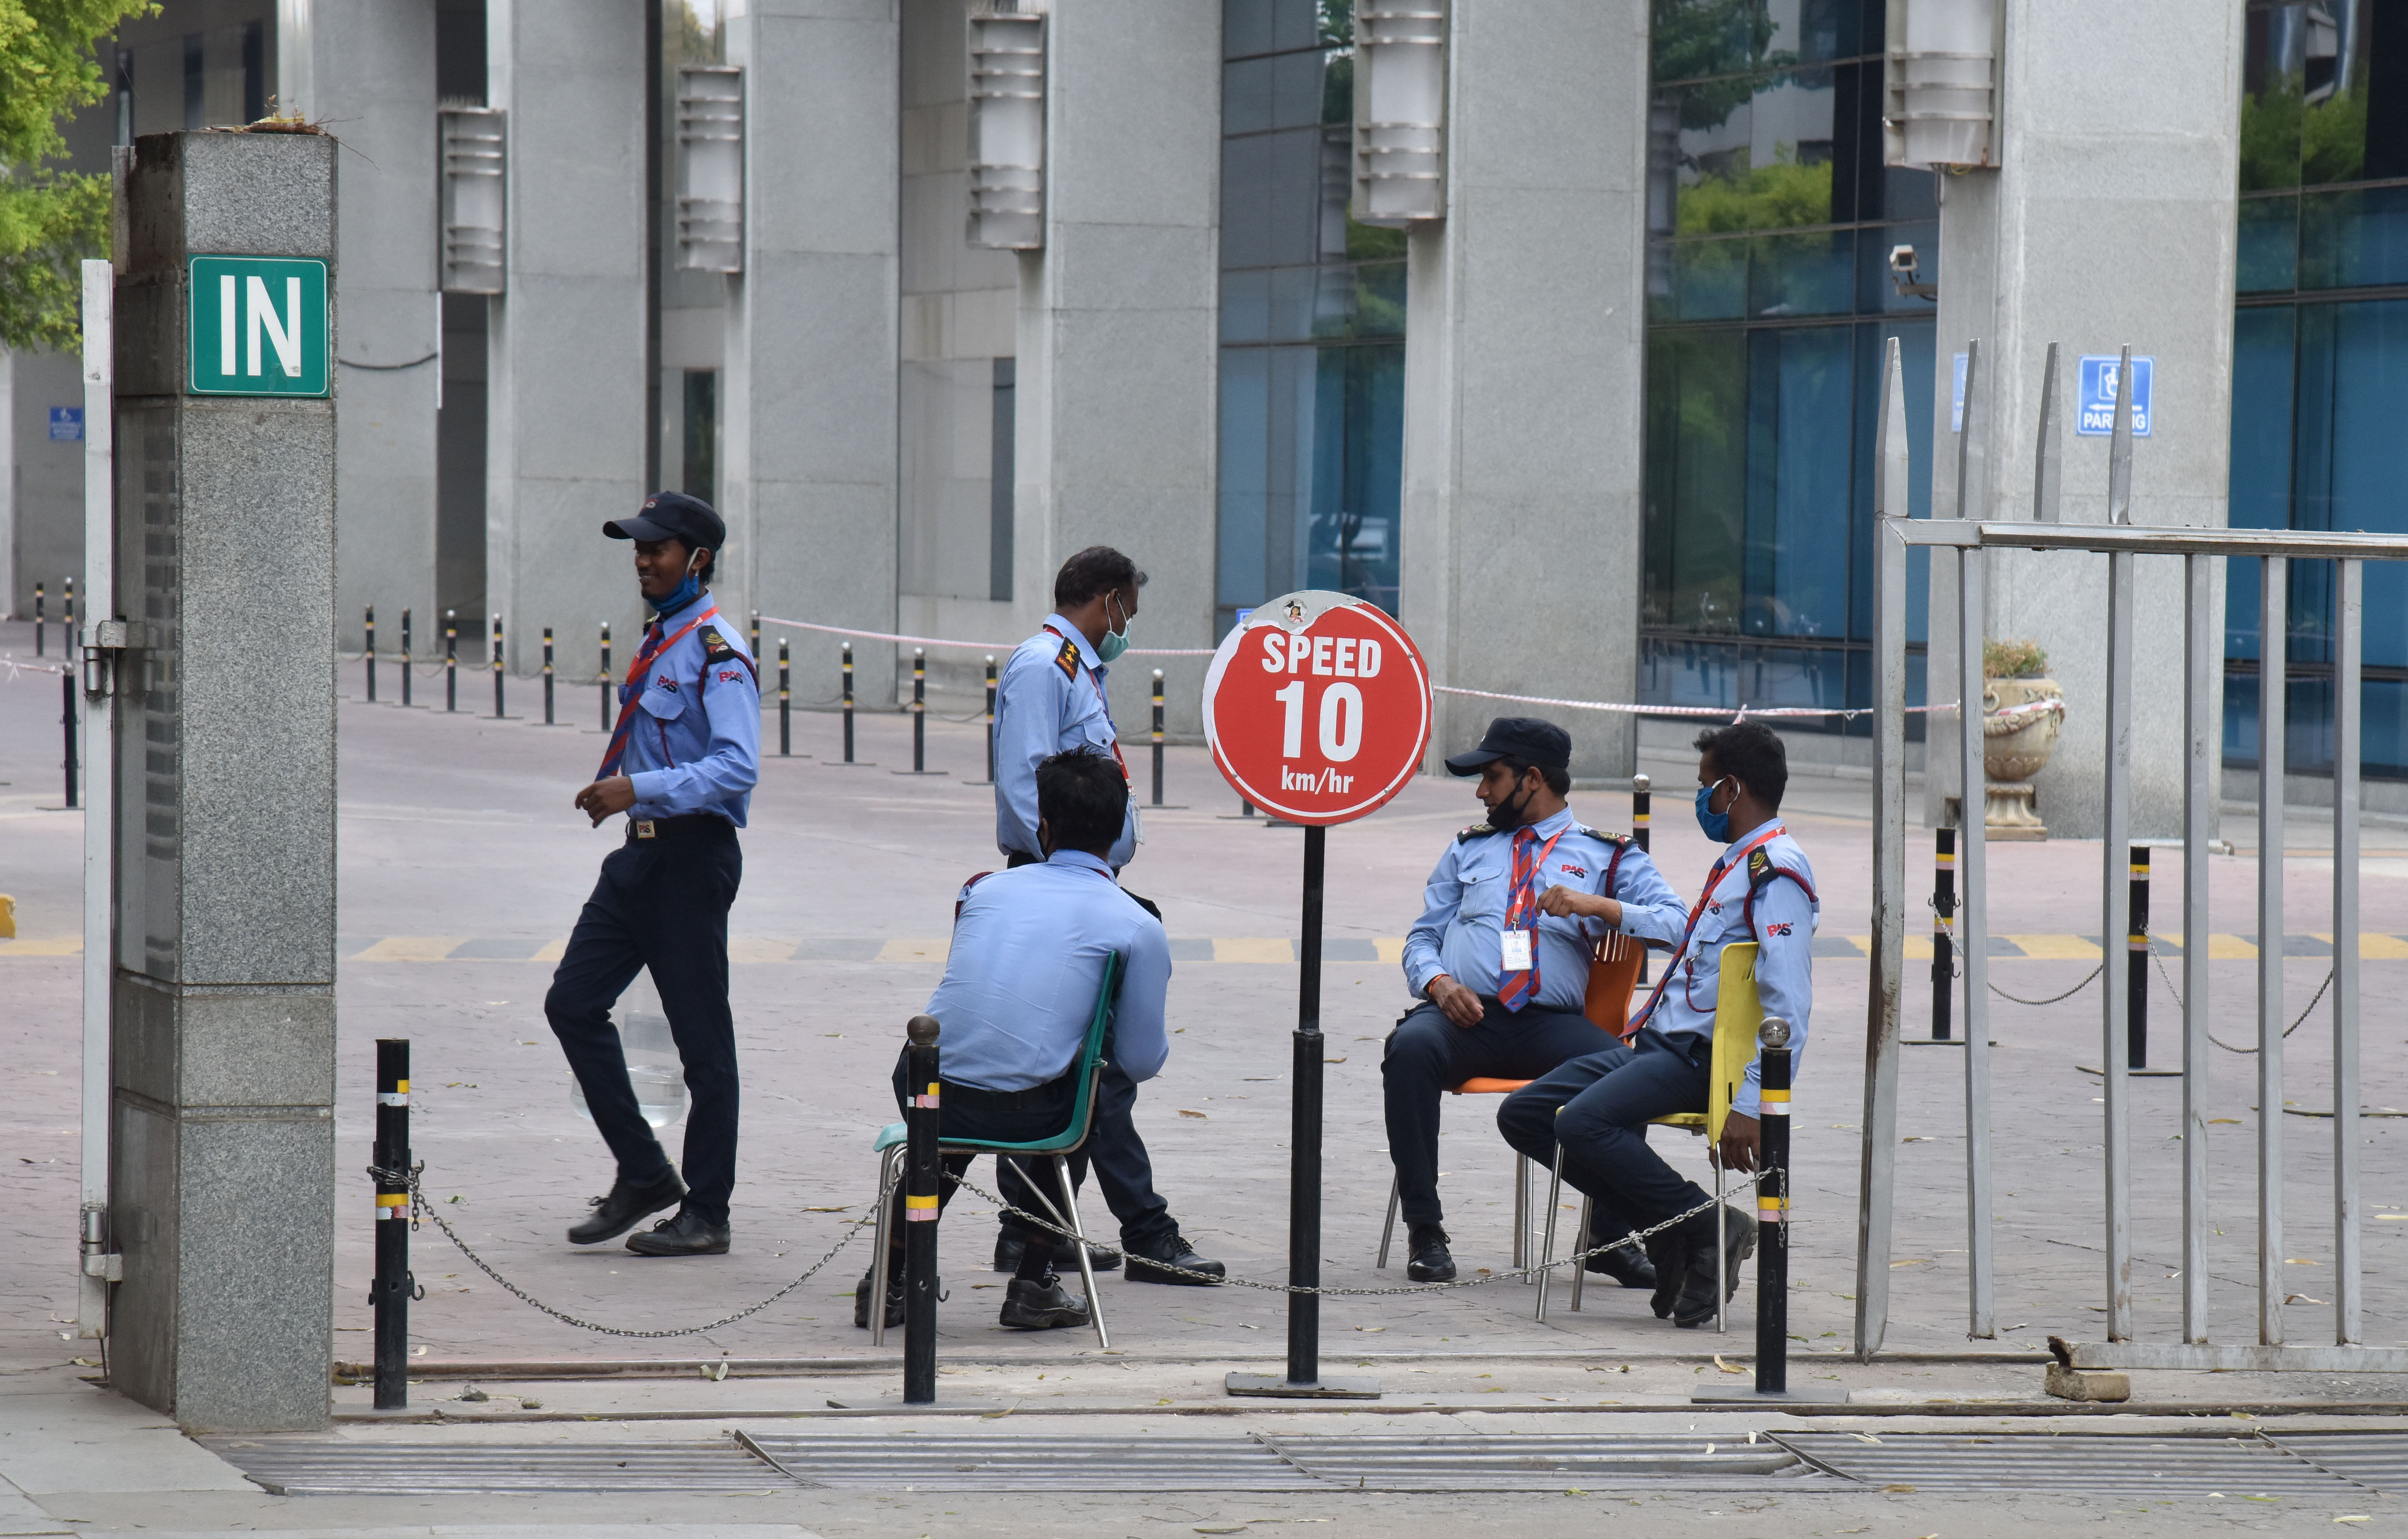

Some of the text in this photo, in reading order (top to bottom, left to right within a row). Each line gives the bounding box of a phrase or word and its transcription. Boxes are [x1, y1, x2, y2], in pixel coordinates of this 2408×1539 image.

[220, 274, 301, 377] IN
[2084, 412, 2146, 430] PARG
[1262, 633, 1382, 678] SPEED
[657, 675, 678, 694] PAS
[719, 671, 743, 684] PAS
[1275, 680, 1363, 762] 10
[1281, 765, 1354, 795] km/hr
[1561, 864, 1585, 879] PAS
[1766, 923, 1792, 937] PAS
